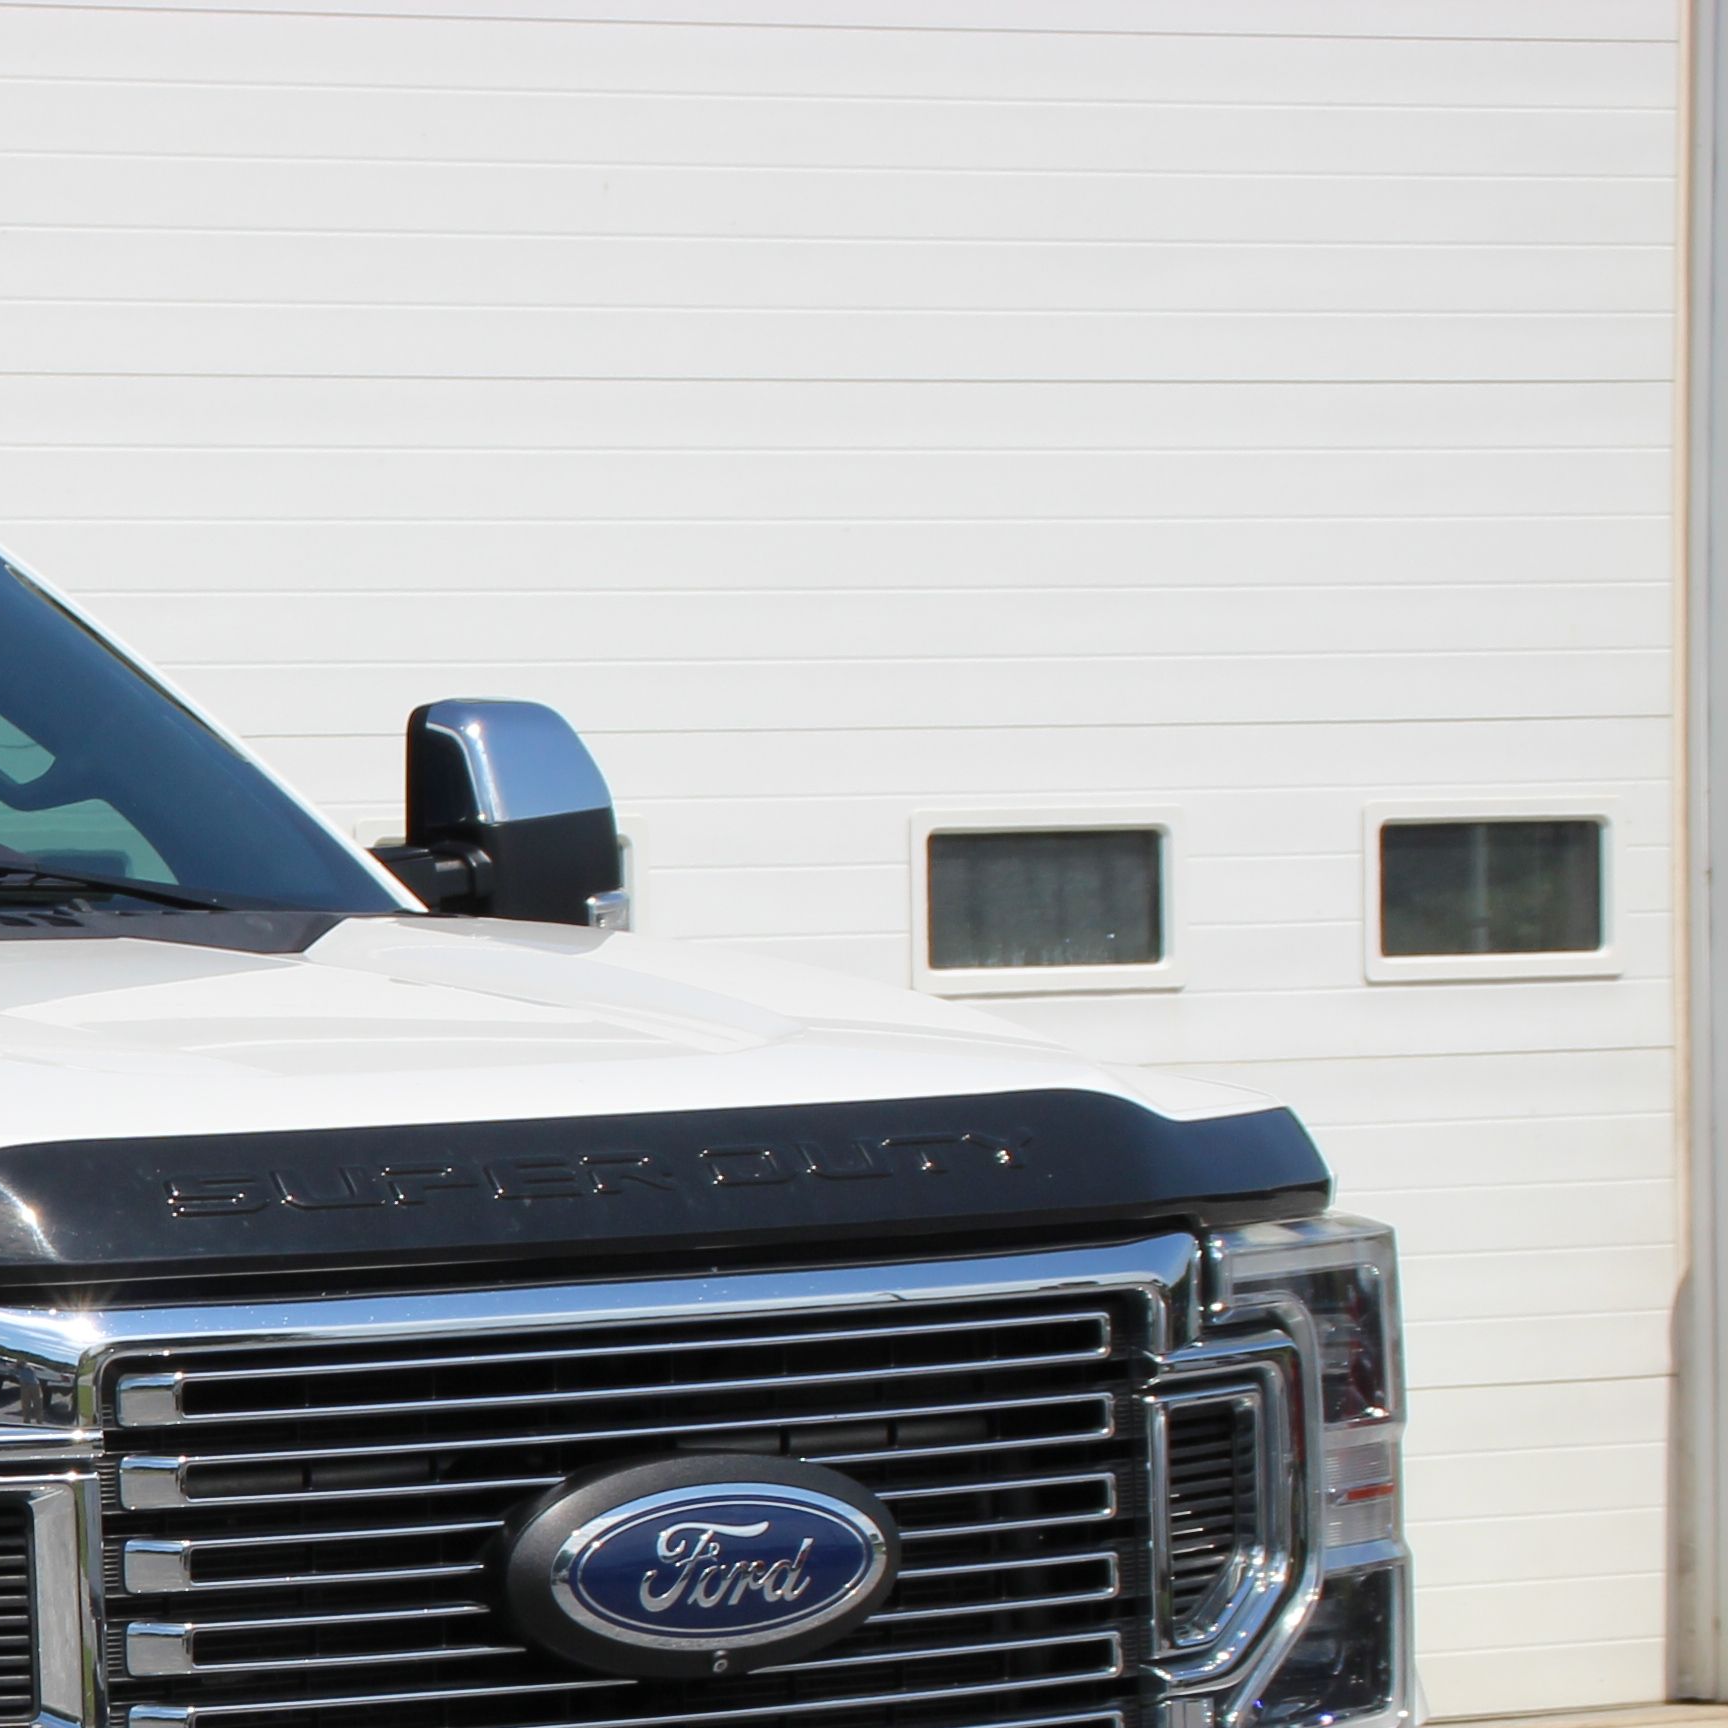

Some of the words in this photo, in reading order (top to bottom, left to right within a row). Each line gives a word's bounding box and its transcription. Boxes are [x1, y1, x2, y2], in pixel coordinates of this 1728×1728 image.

[162, 1150, 679, 1217] SUPER
[698, 1126, 1034, 1187] DUTY
[639, 1520, 814, 1612] Ford
